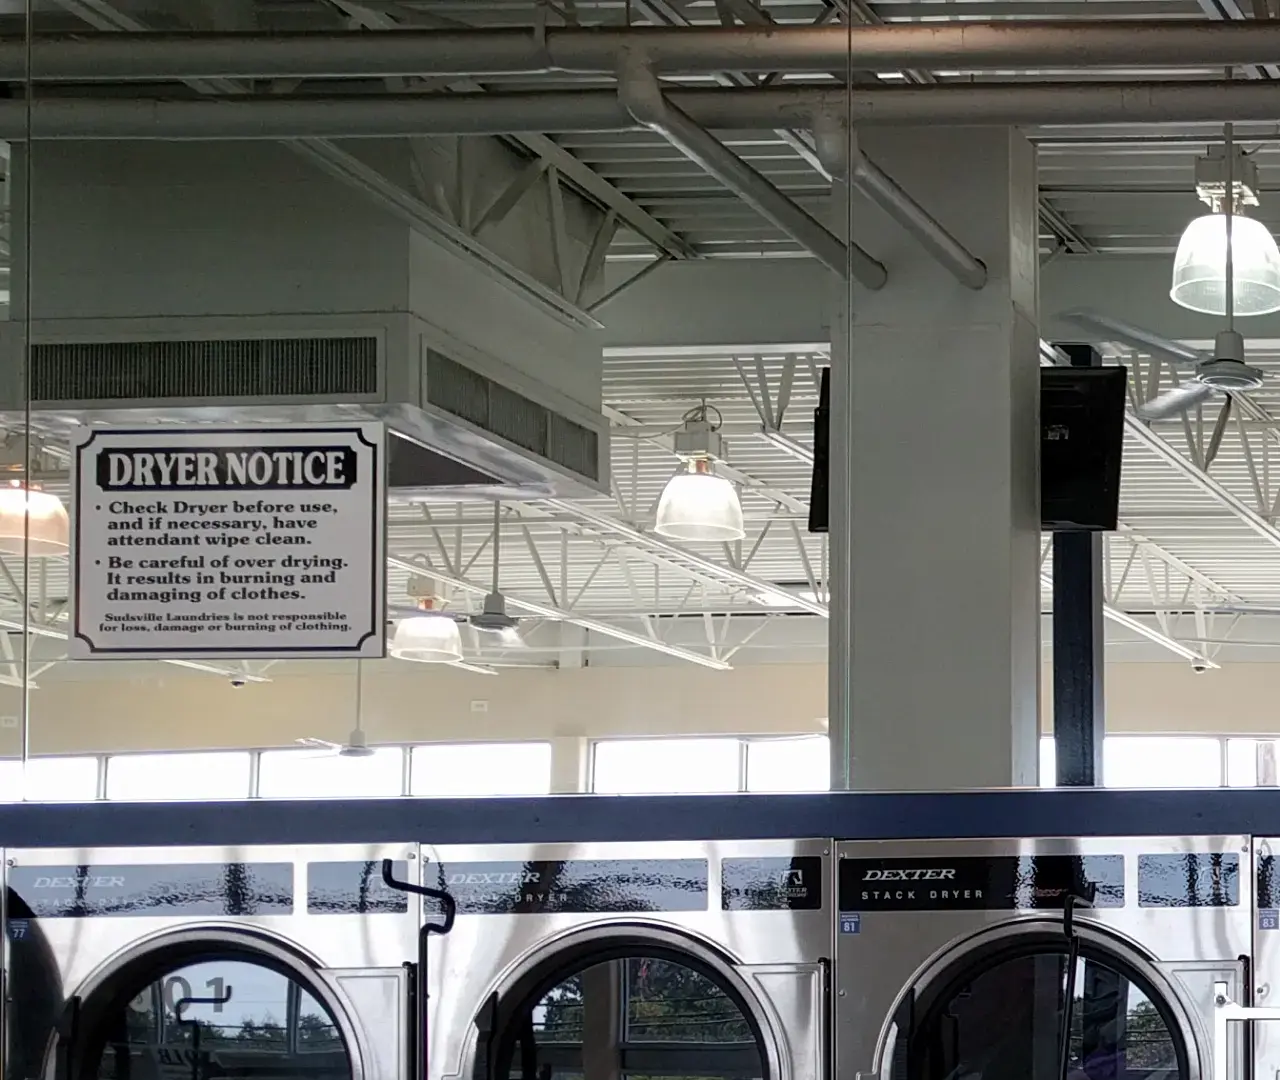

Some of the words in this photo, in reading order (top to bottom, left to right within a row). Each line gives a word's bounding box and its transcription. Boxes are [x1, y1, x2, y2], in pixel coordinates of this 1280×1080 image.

[109, 454, 219, 486] DRYER
[226, 452, 345, 485] NOTICE
[109, 501, 169, 515] Check
[173, 501, 229, 517] Dryer
[233, 500, 295, 514] before
[300, 504, 338, 514] use,
[108, 517, 144, 531] and
[149, 517, 163, 531] if
[168, 520, 268, 532] necessary,
[273, 516, 318, 529] have
[108, 533, 201, 546] attendant
[205, 533, 251, 548] wipe
[256, 532, 312, 546] clean.
[108, 556, 134, 569] Be
[139, 556, 205, 569] careful
[210, 555, 230, 569] of
[234, 559, 277, 569] over
[281, 555, 349, 571] drying.
[108, 572, 122, 586] It
[127, 572, 192, 585] results
[197, 572, 215, 585] in
[220, 572, 296, 586] burning
[300, 571, 336, 584] and
[107, 588, 202, 604] damaging
[207, 587, 227, 601] of
[231, 587, 306, 600] clothes.
[105, 613, 163, 622] Sudsville
[167, 613, 230, 622] Laundries
[233, 612, 245, 621] is
[272, 612, 347, 622] responsible
[100, 623, 119, 633] for
[122, 623, 151, 633] loss,
[154, 623, 205, 633] damage
[225, 623, 276, 633] burning
[280, 622, 293, 631] of
[296, 622, 352, 632] clothing.
[448, 872, 541, 885] DEXTER
[861, 868, 957, 881] DEXTER
[515, 893, 568, 903] DRYER
[860, 890, 917, 900] STACK
[930, 889, 984, 899] DRYER
[843, 922, 855, 931] 81
[1262, 918, 1275, 927] 83
